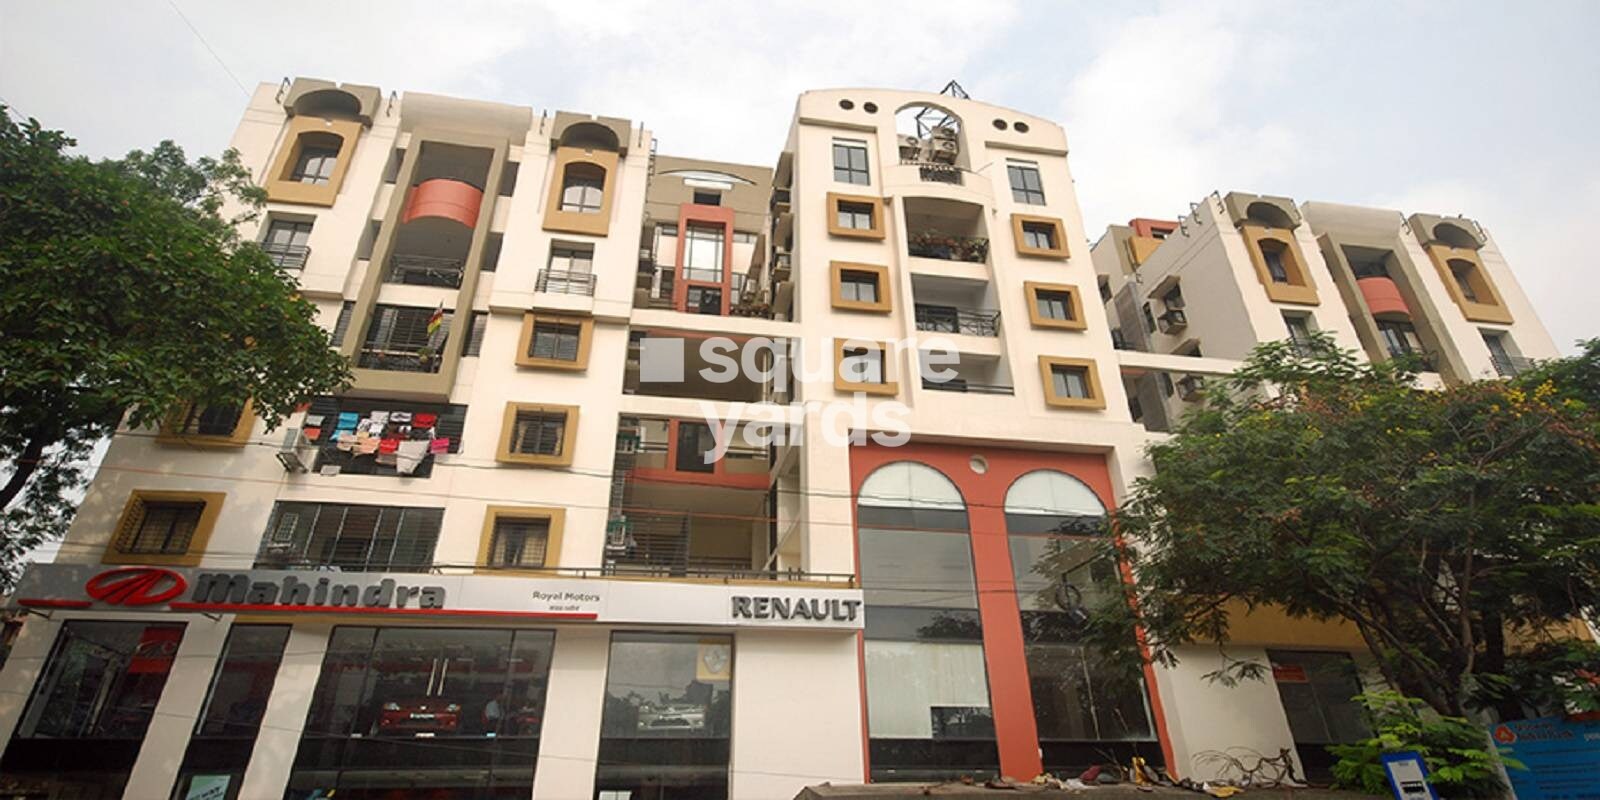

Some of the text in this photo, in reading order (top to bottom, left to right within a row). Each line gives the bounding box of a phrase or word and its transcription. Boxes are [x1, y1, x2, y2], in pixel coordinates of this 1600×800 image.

[192, 573, 446, 609] Mahindra
[532, 591, 601, 602] Royal Motors
[732, 595, 862, 621] RENAULT
